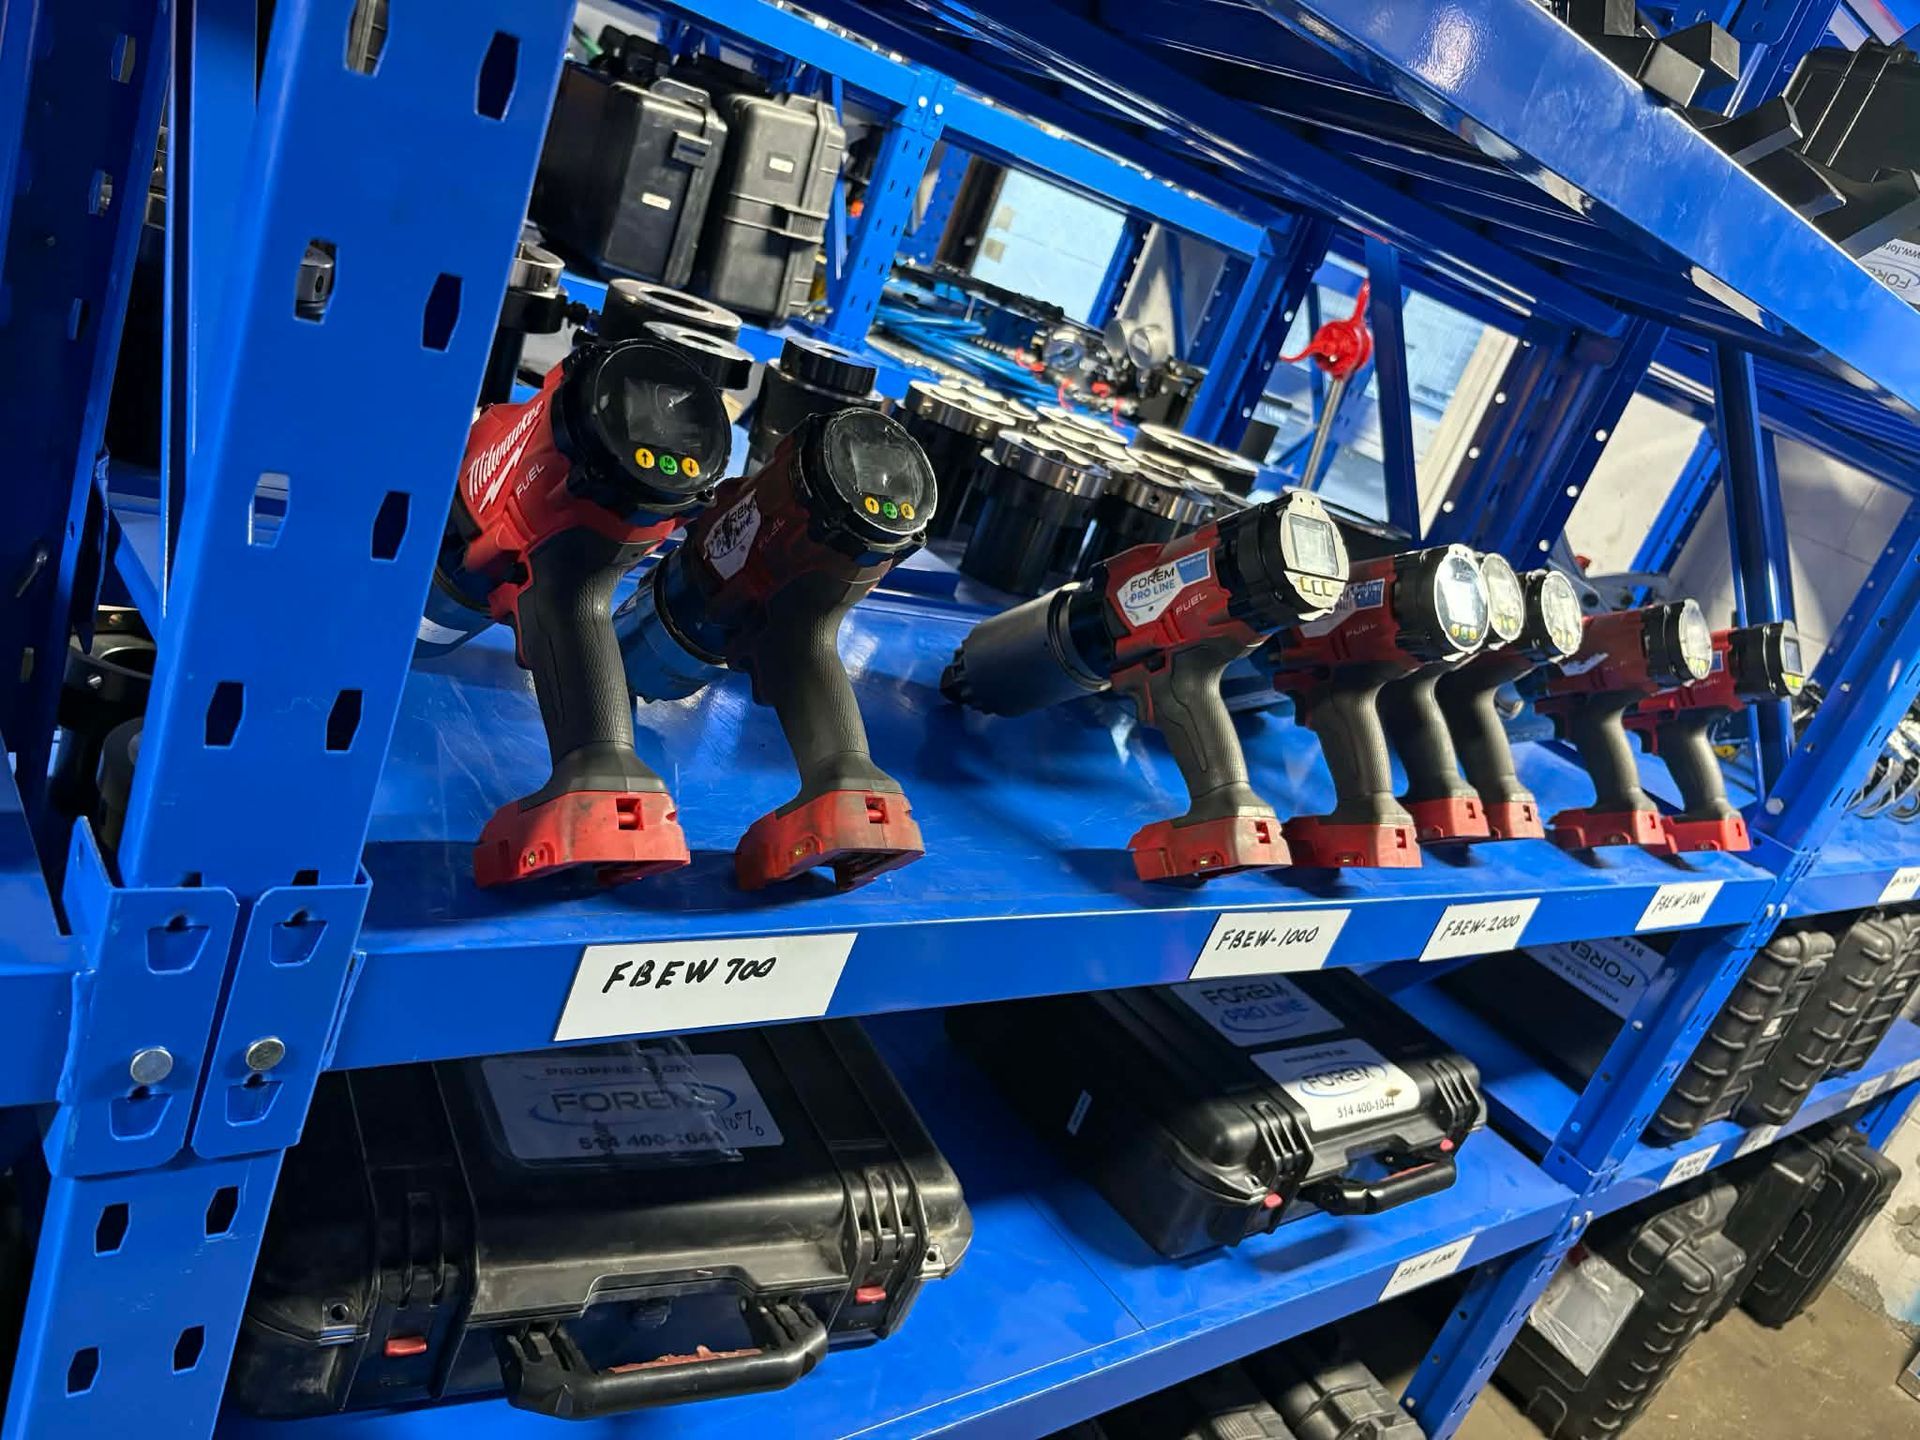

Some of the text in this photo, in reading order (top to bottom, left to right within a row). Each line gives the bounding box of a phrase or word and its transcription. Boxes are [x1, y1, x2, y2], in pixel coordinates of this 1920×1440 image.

[466, 400, 544, 502] Milwaukee
[515, 462, 545, 499] FUEL
[1130, 567, 1175, 591] FOREM
[1130, 579, 1176, 603] PRO LINE
[1175, 592, 1208, 616] FUEL
[1215, 926, 1320, 951] FBEW-1000
[602, 957, 777, 993] FBEW 700
[1200, 980, 1290, 1006] FOREM
[1303, 1066, 1376, 1089] FOREM
[1337, 1096, 1396, 1119] 514 400-1044
